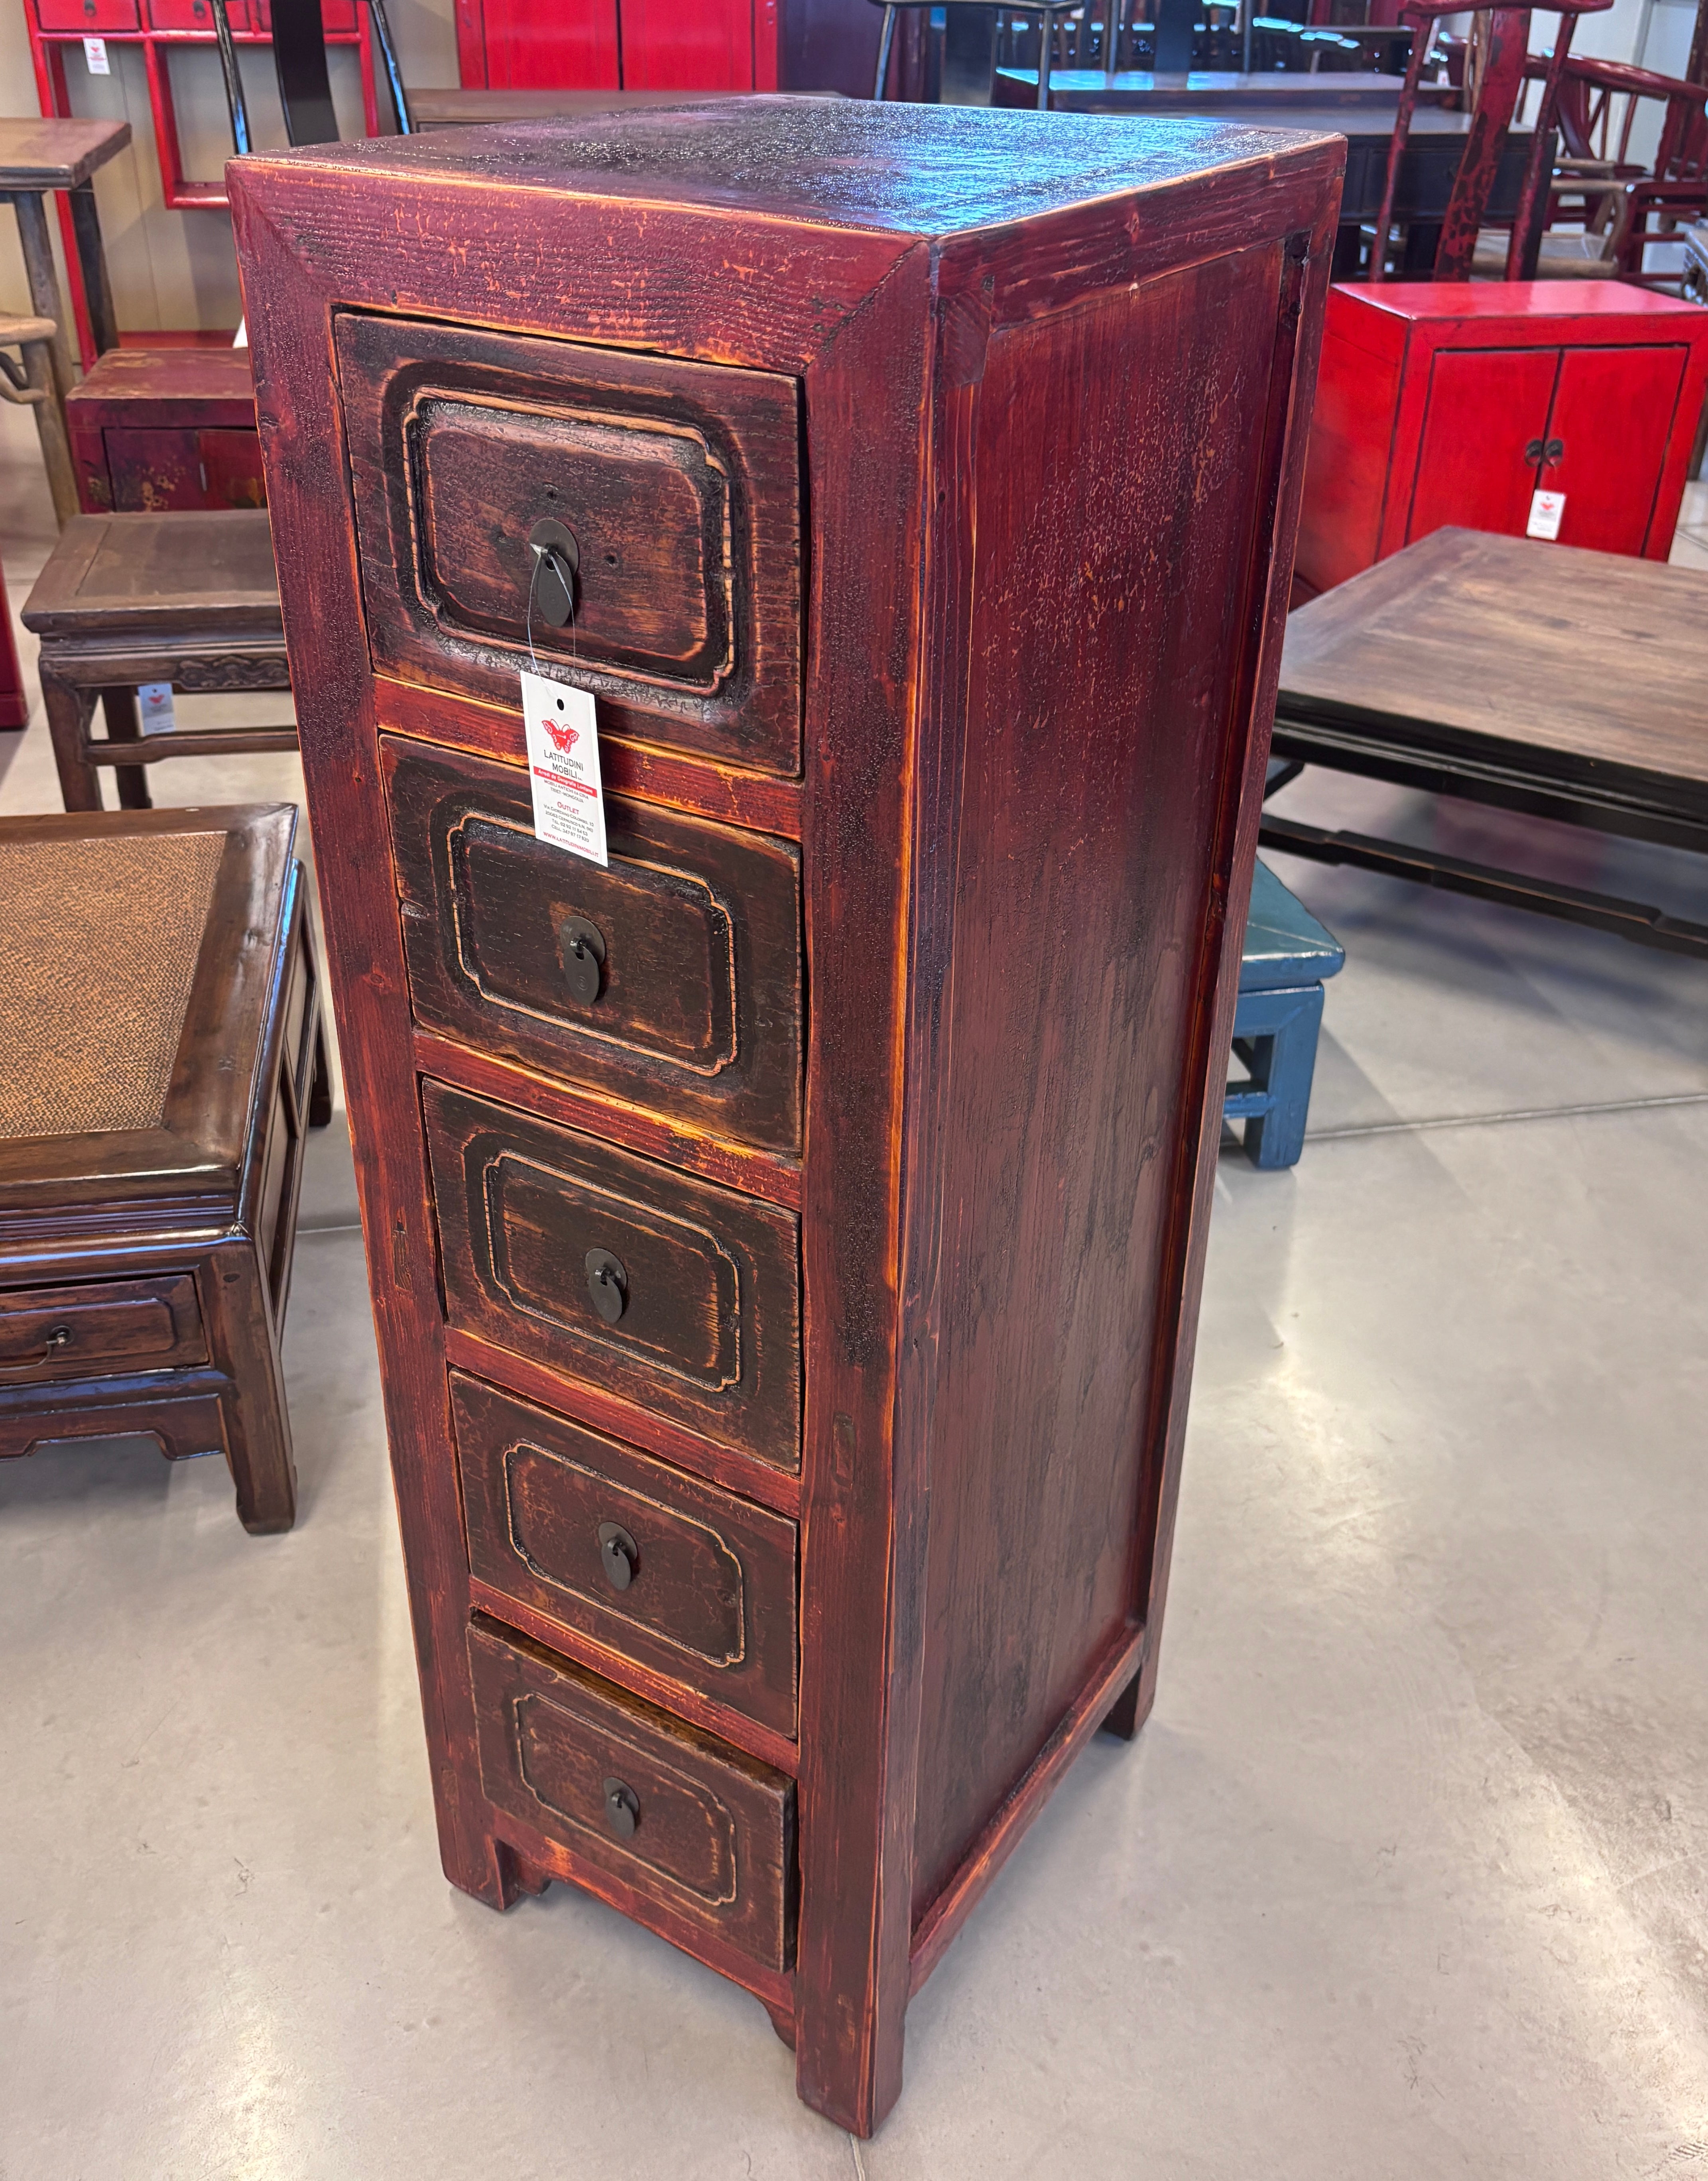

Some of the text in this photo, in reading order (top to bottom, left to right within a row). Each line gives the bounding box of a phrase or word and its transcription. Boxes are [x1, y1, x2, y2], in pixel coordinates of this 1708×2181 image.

[544, 749, 583, 771] LATITUDINI
[553, 763, 577, 779] MOBILI
[557, 802, 579, 814] OUTLET
